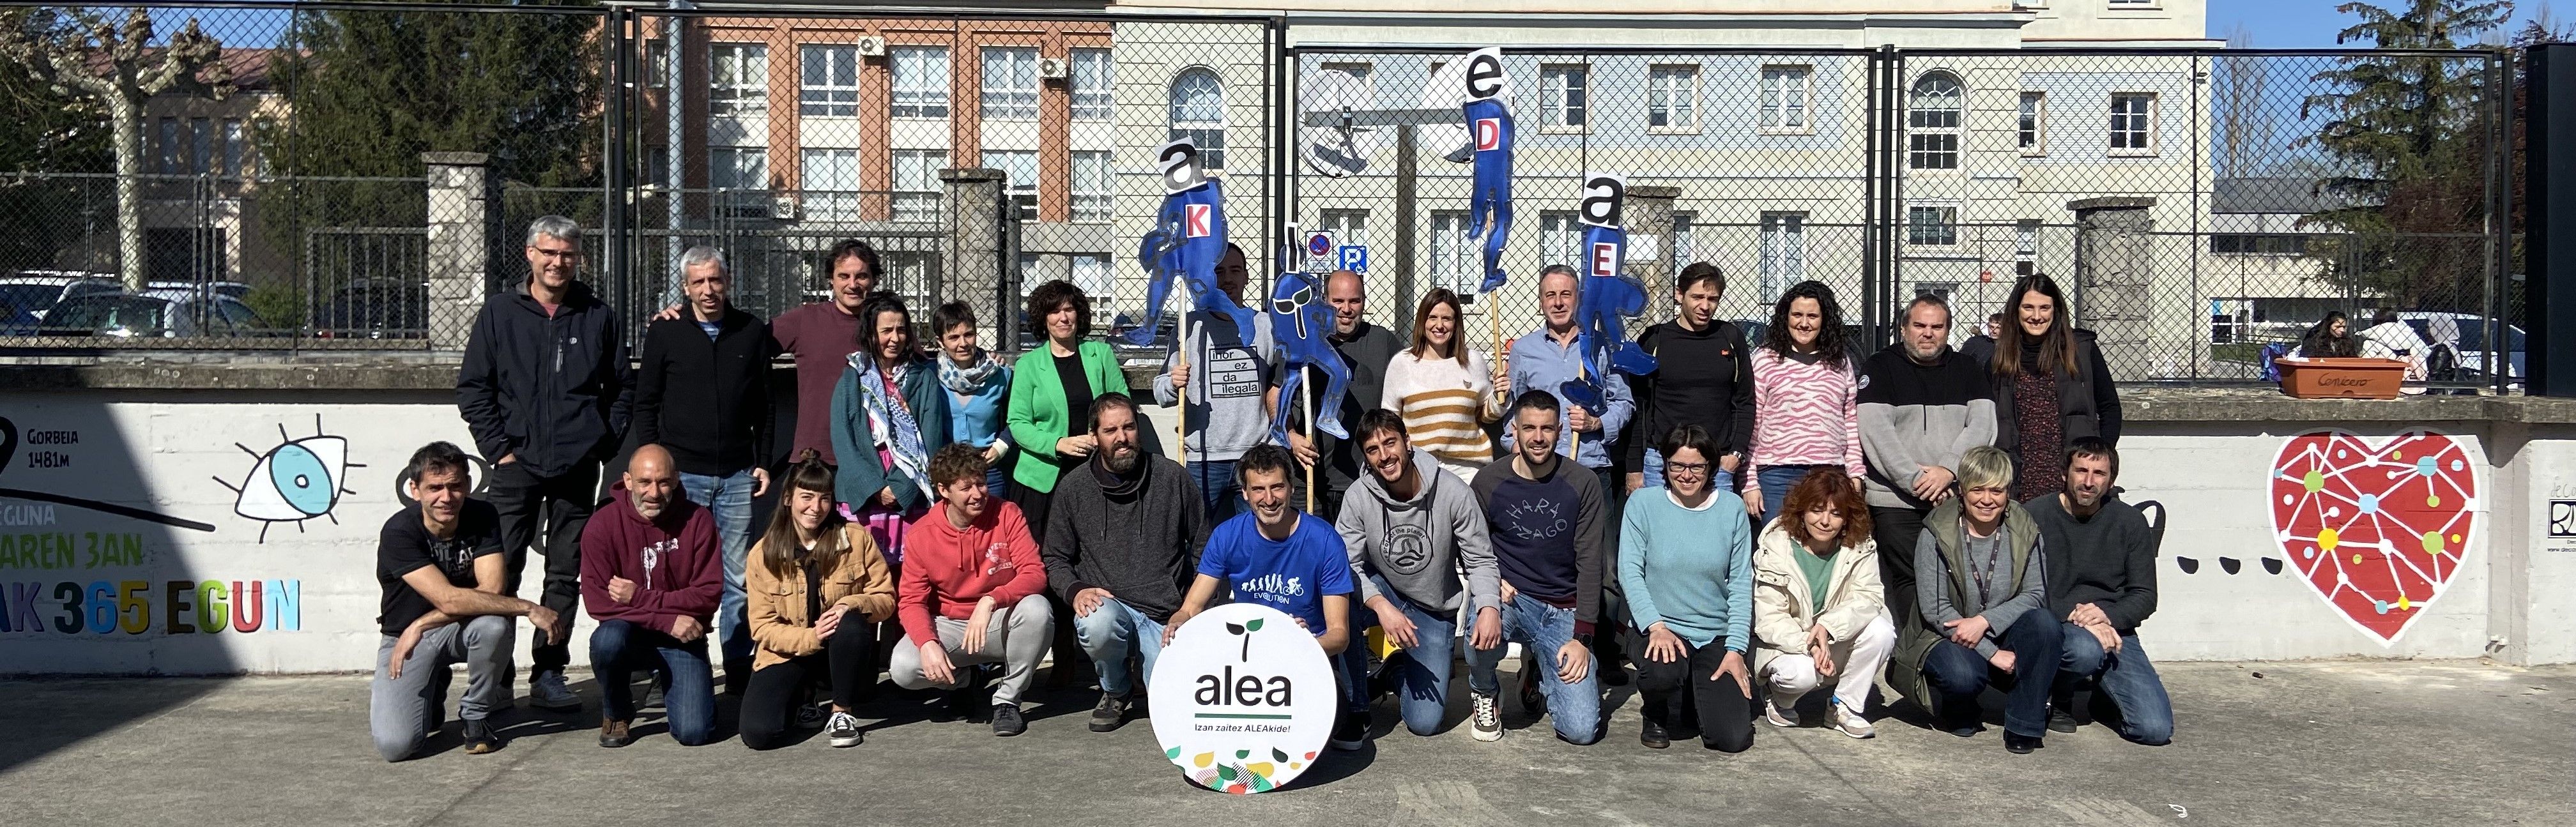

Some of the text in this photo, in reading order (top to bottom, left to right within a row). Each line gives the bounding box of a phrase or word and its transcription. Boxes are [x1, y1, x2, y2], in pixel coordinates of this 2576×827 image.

[1466, 54, 1501, 98] e
[1478, 120, 1498, 149] D
[1160, 144, 1206, 190] a
[1581, 177, 1625, 226] a
[1187, 206, 1209, 236] K
[1593, 245, 1613, 275] E
[1222, 383, 1257, 394] ilegala
[1223, 373, 1236, 381] da
[2318, 372, 2375, 386] Cenicero
[27, 429, 79, 444] GORBEIA
[0, 505, 56, 526] GUNA
[1506, 497, 1560, 519] HARA
[84, 531, 144, 570] 3AN
[54, 580, 151, 635] 365
[166, 579, 301, 634] EGUN
[1254, 593, 1290, 605] EVOLUTION
[1194, 665, 1291, 706] alea
[1215, 724, 1243, 732] zaitez
[1244, 724, 1291, 732] ALEAkide!
